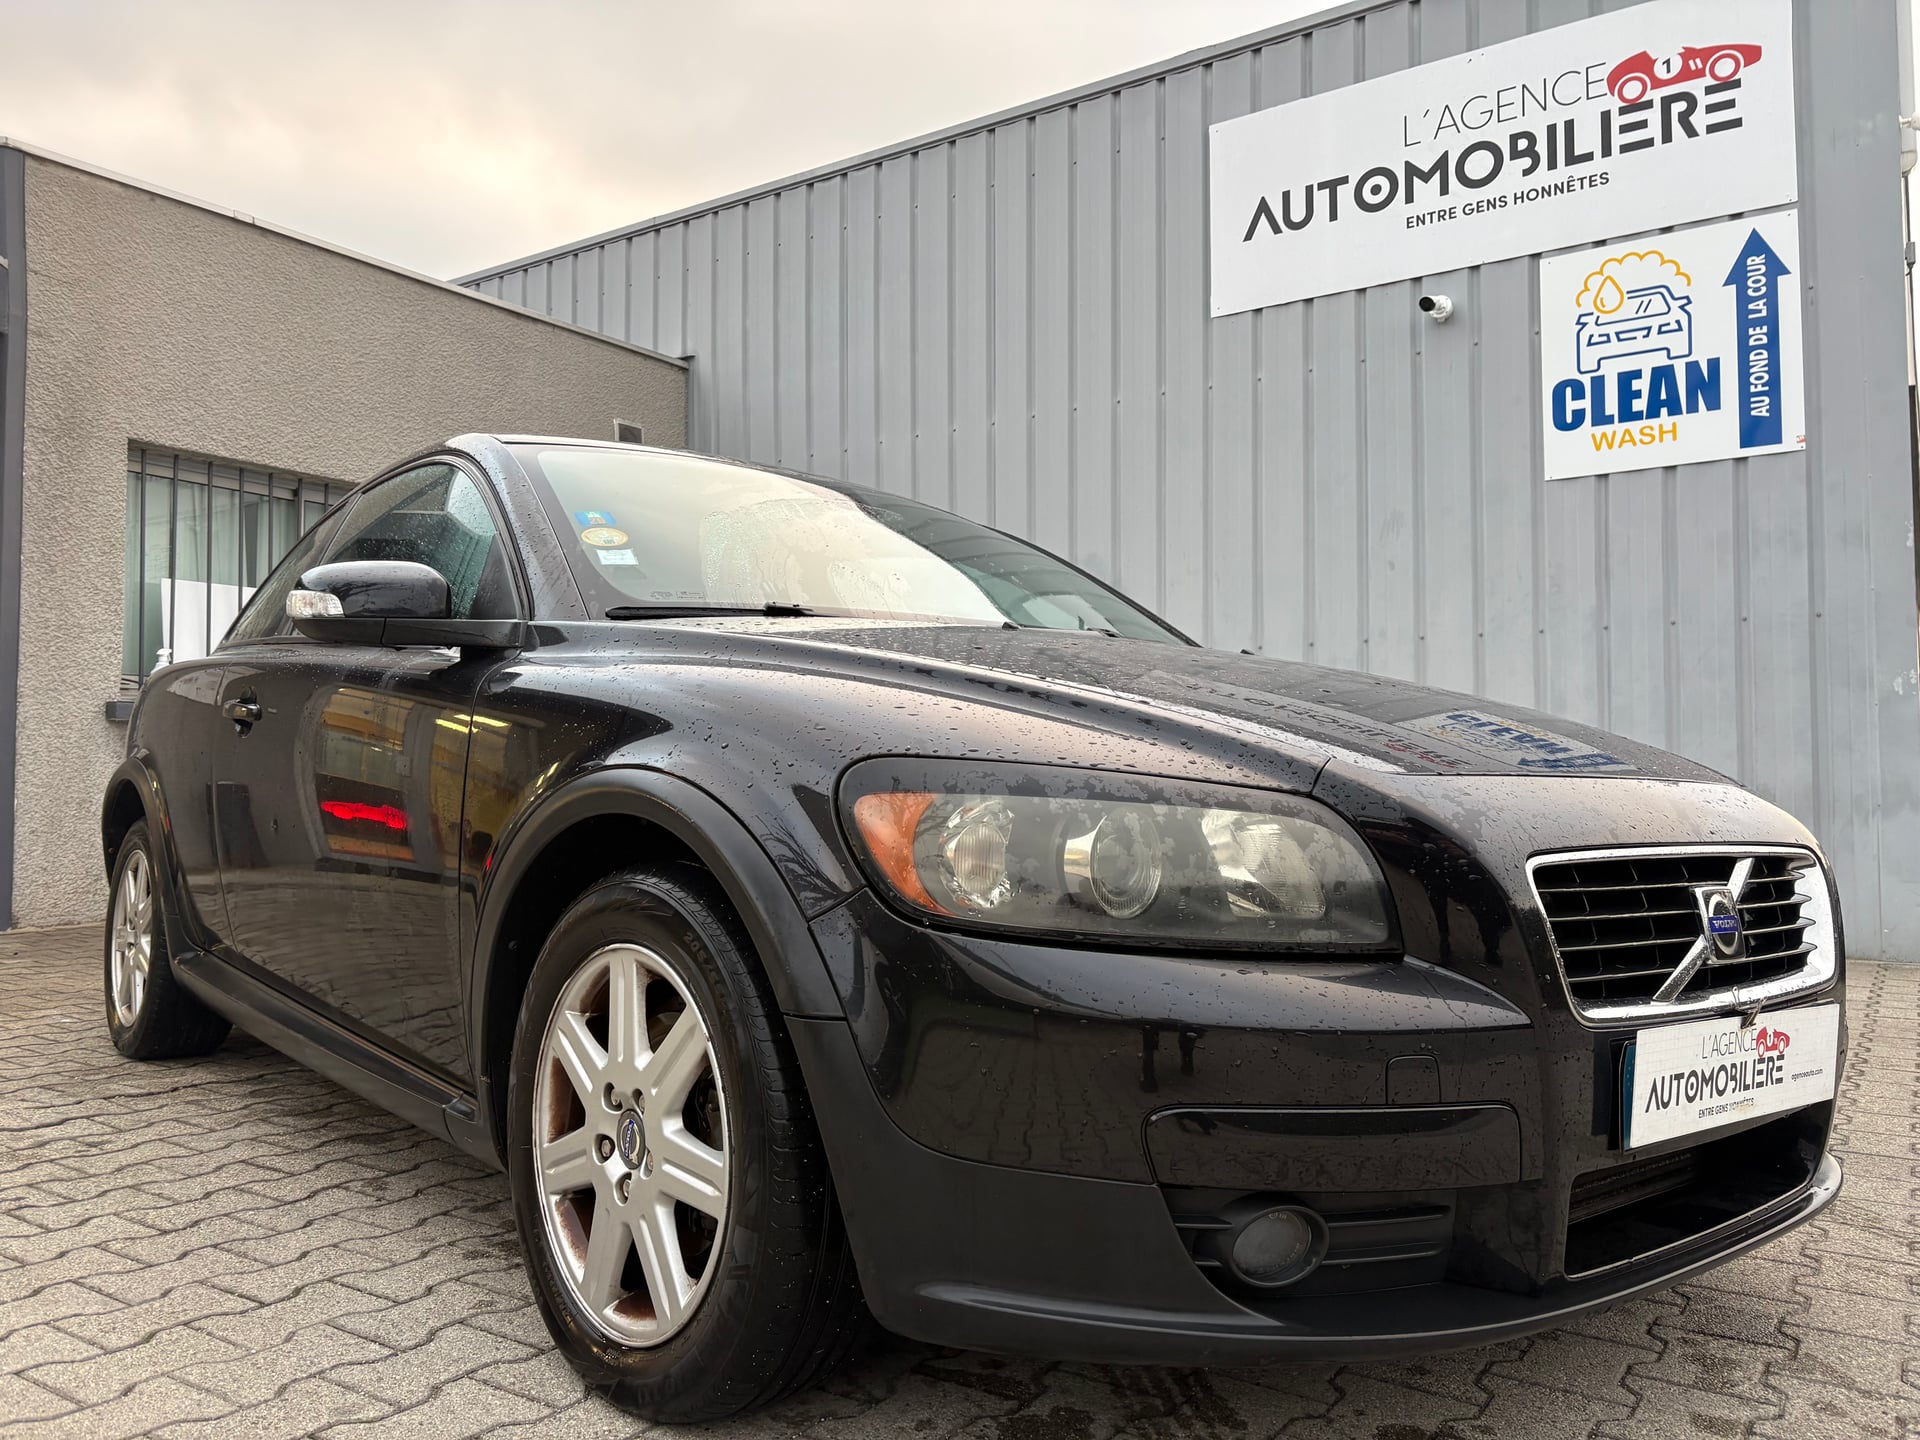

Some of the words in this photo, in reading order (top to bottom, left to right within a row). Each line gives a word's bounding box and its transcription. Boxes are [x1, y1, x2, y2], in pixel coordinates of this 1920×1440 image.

[1403, 62, 1608, 147] L'AGENCE
[1406, 206, 1458, 229] ENTRE
[1462, 195, 1508, 216] GENS
[1513, 171, 1610, 205] HONNÊTES
[1747, 253, 1767, 297] COUR
[1748, 298, 1767, 319] LA
[1749, 325, 1768, 346] DE
[1749, 350, 1770, 393] FOND
[1552, 357, 1721, 431] CLEAN
[1750, 398, 1770, 417] AU
[1591, 421, 1677, 451] WASH
[1702, 1028, 1757, 1059] L'AGENCE
[1698, 1106, 1714, 1118] ENTRE
[1715, 1103, 1728, 1114] GENS
